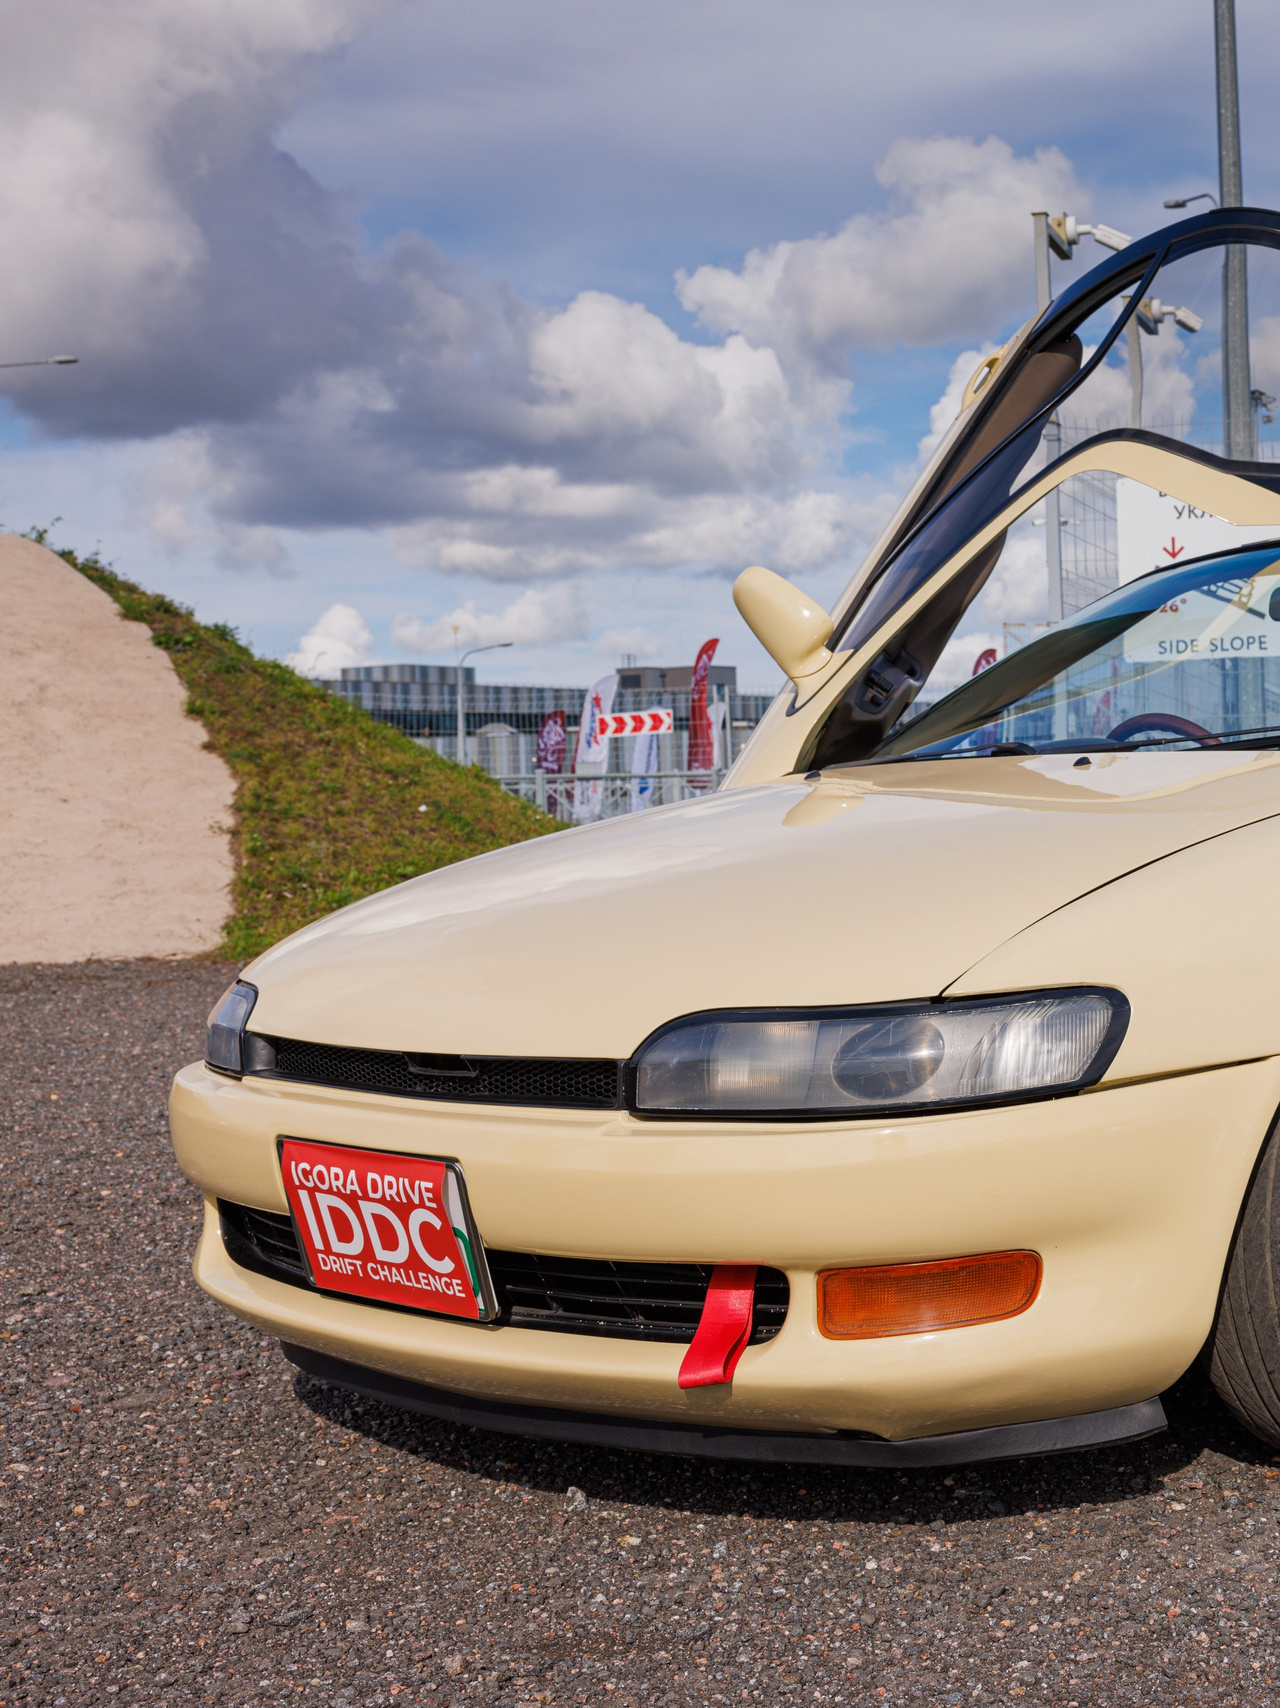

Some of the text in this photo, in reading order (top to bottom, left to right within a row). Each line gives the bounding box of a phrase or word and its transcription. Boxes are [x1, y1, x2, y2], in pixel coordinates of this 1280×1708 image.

[1158, 635, 1268, 655] SIDE SLOPE
[291, 1161, 438, 1208] IGORA DRIVE
[298, 1189, 456, 1274] IDDC
[317, 1253, 466, 1298] DRIFT CHALLENGE
